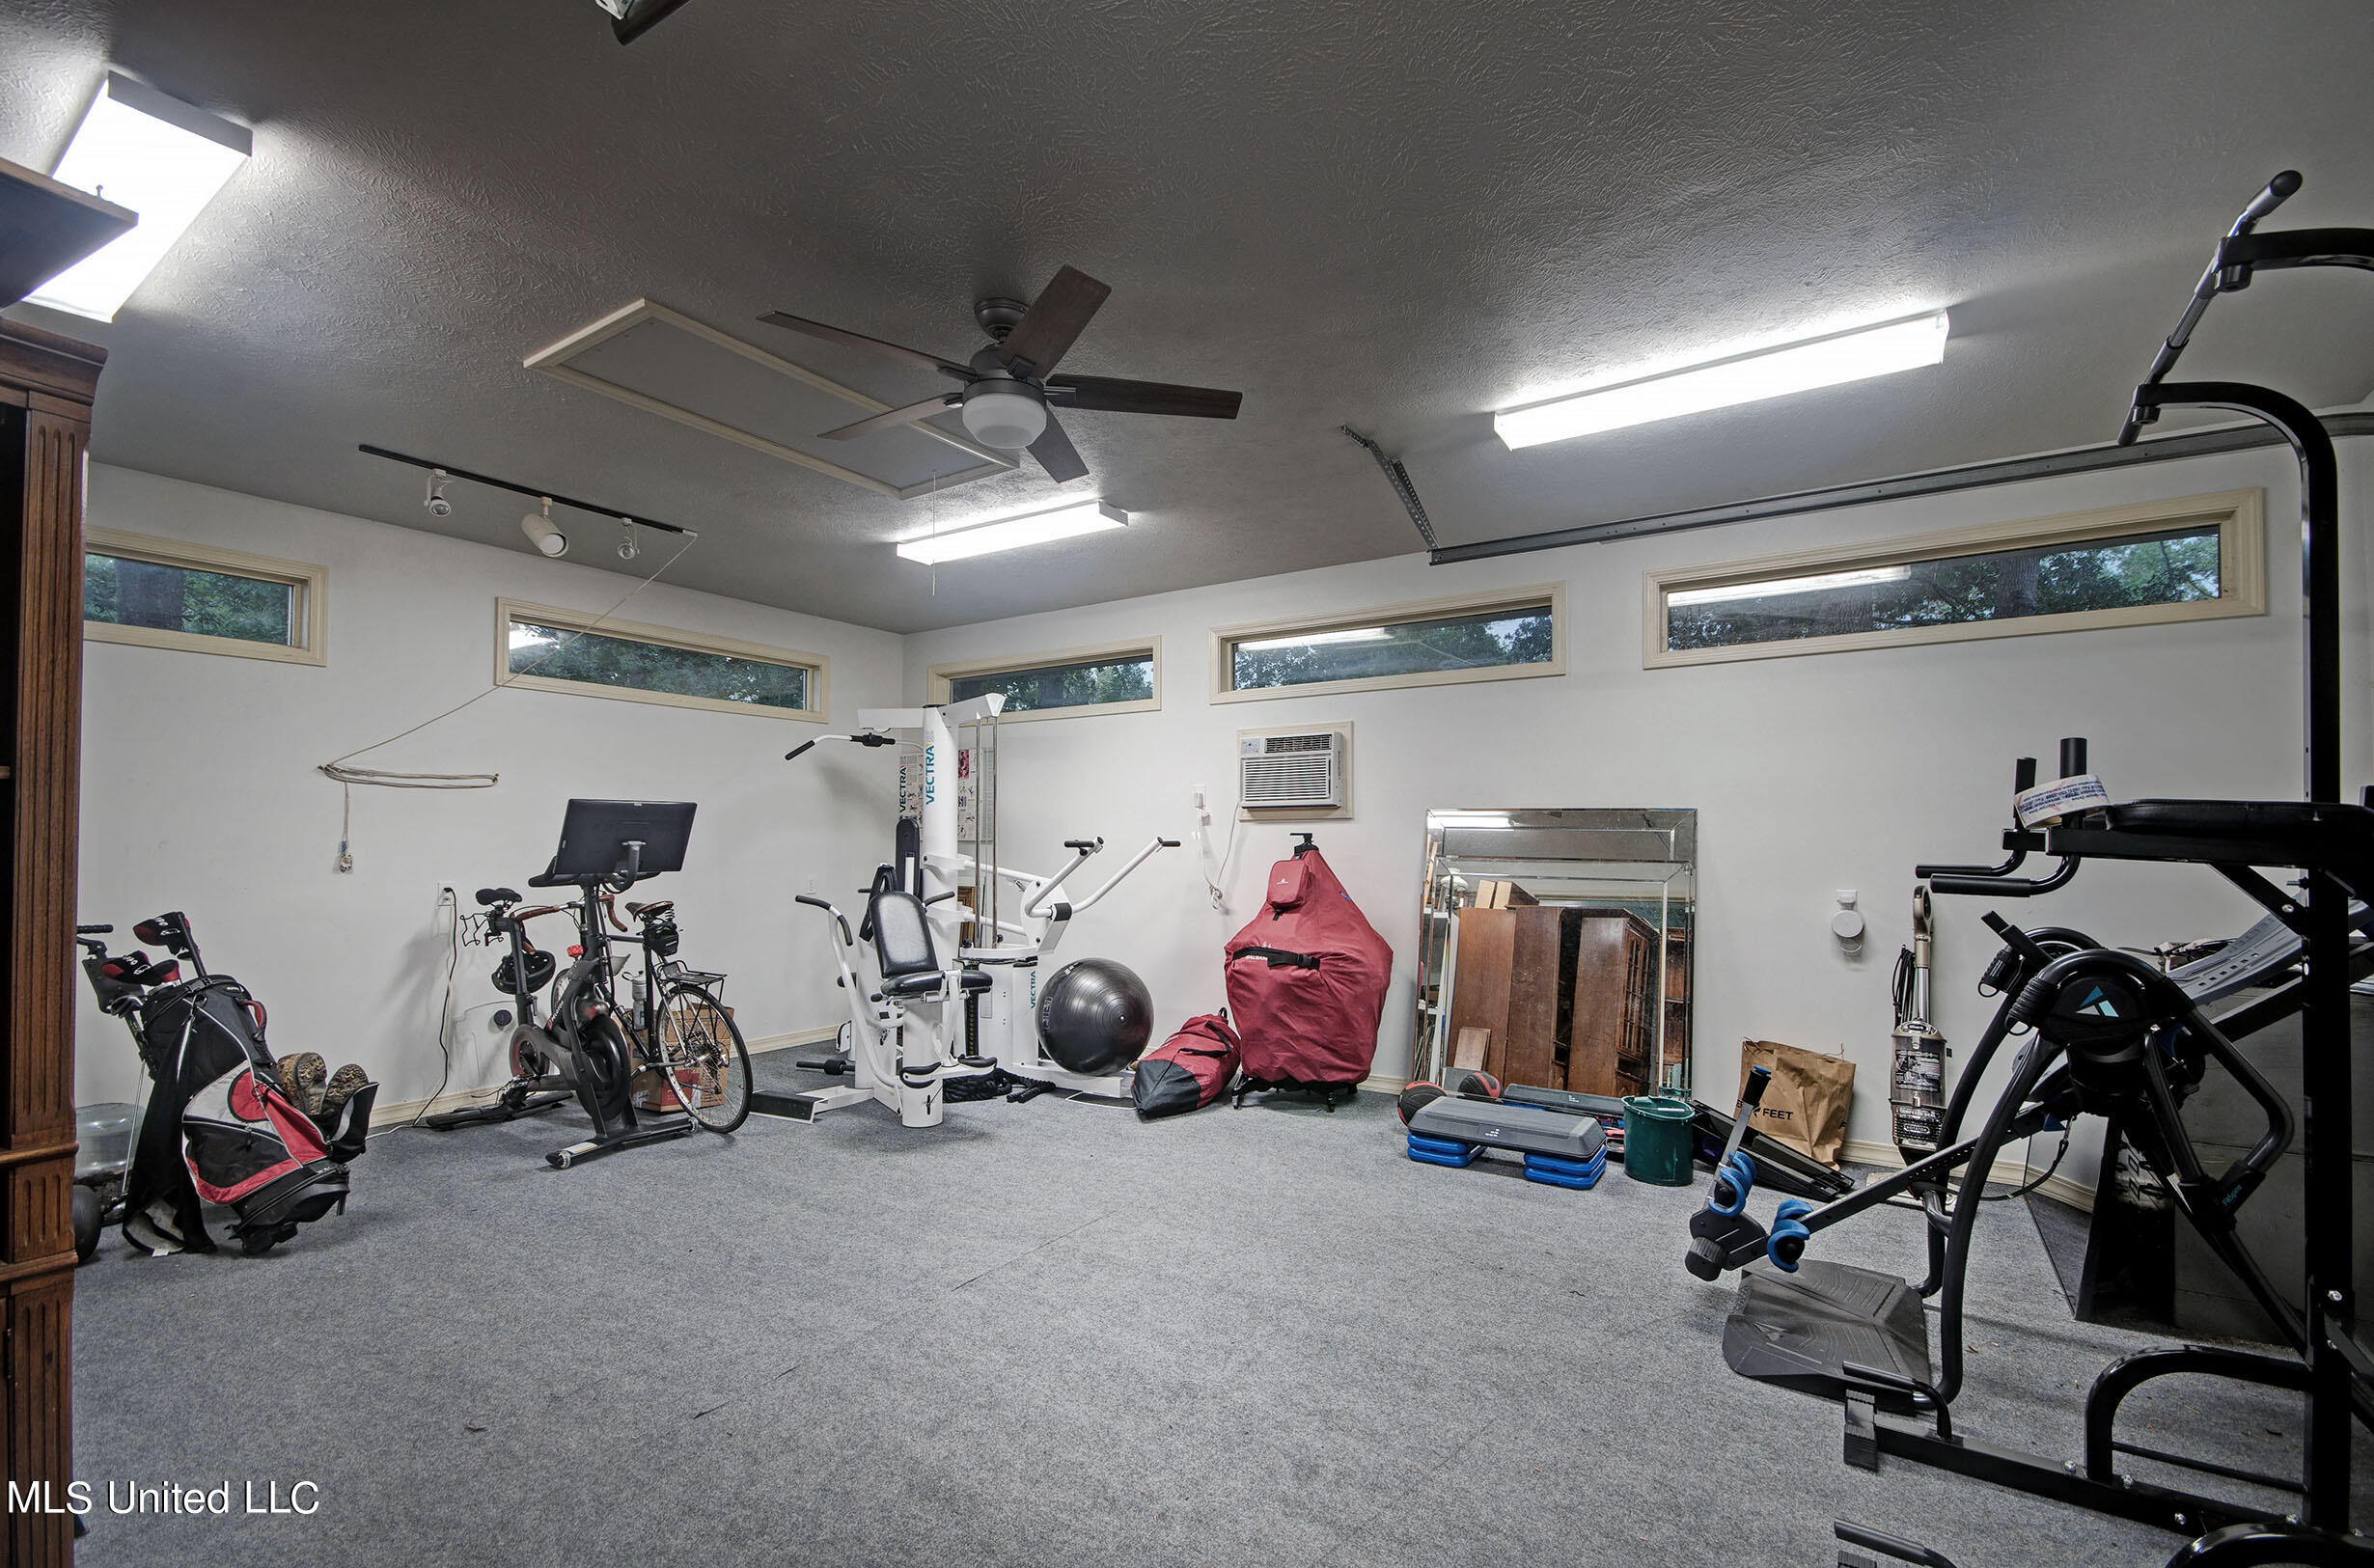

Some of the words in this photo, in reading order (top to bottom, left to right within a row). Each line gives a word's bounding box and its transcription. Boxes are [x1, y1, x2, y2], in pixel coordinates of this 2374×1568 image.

[898, 767, 907, 812] VECTRA
[925, 745, 935, 806] VECTRA
[1762, 1108, 1794, 1120] FEET
